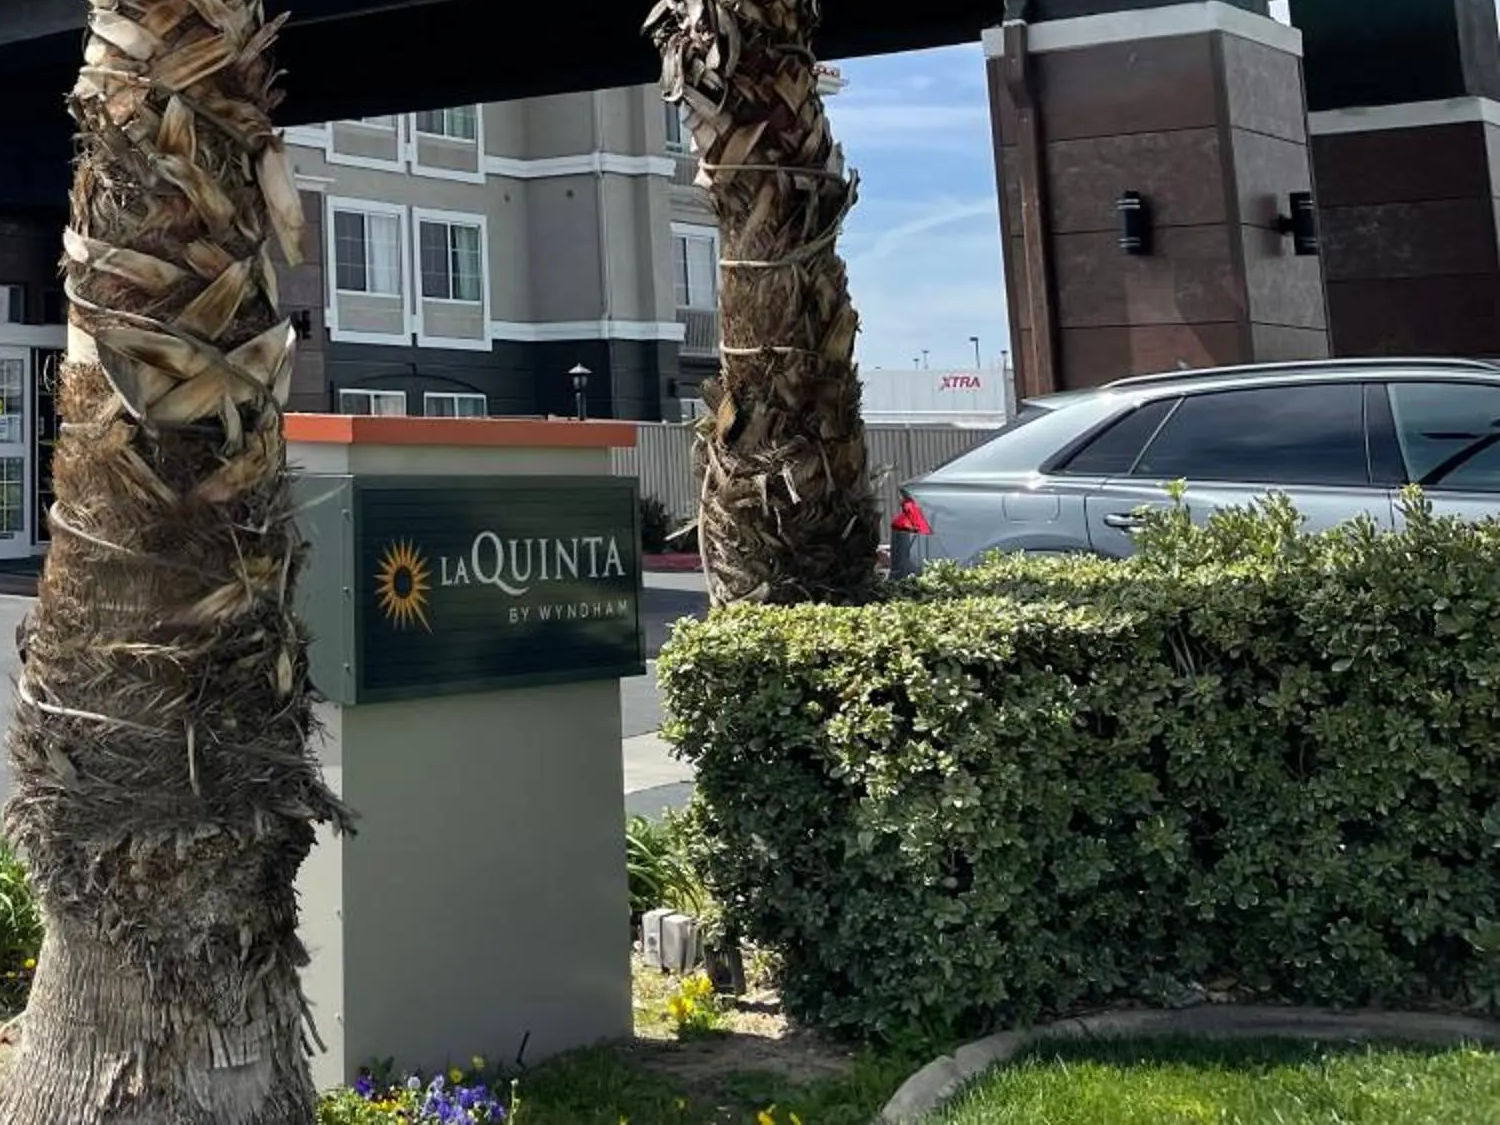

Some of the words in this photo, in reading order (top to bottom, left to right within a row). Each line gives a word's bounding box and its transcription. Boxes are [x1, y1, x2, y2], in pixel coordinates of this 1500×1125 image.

[940, 376, 981, 391] XTRA
[471, 530, 627, 596] QUINTA
[508, 606, 530, 624] BY
[538, 599, 629, 622] WYNDHAM
